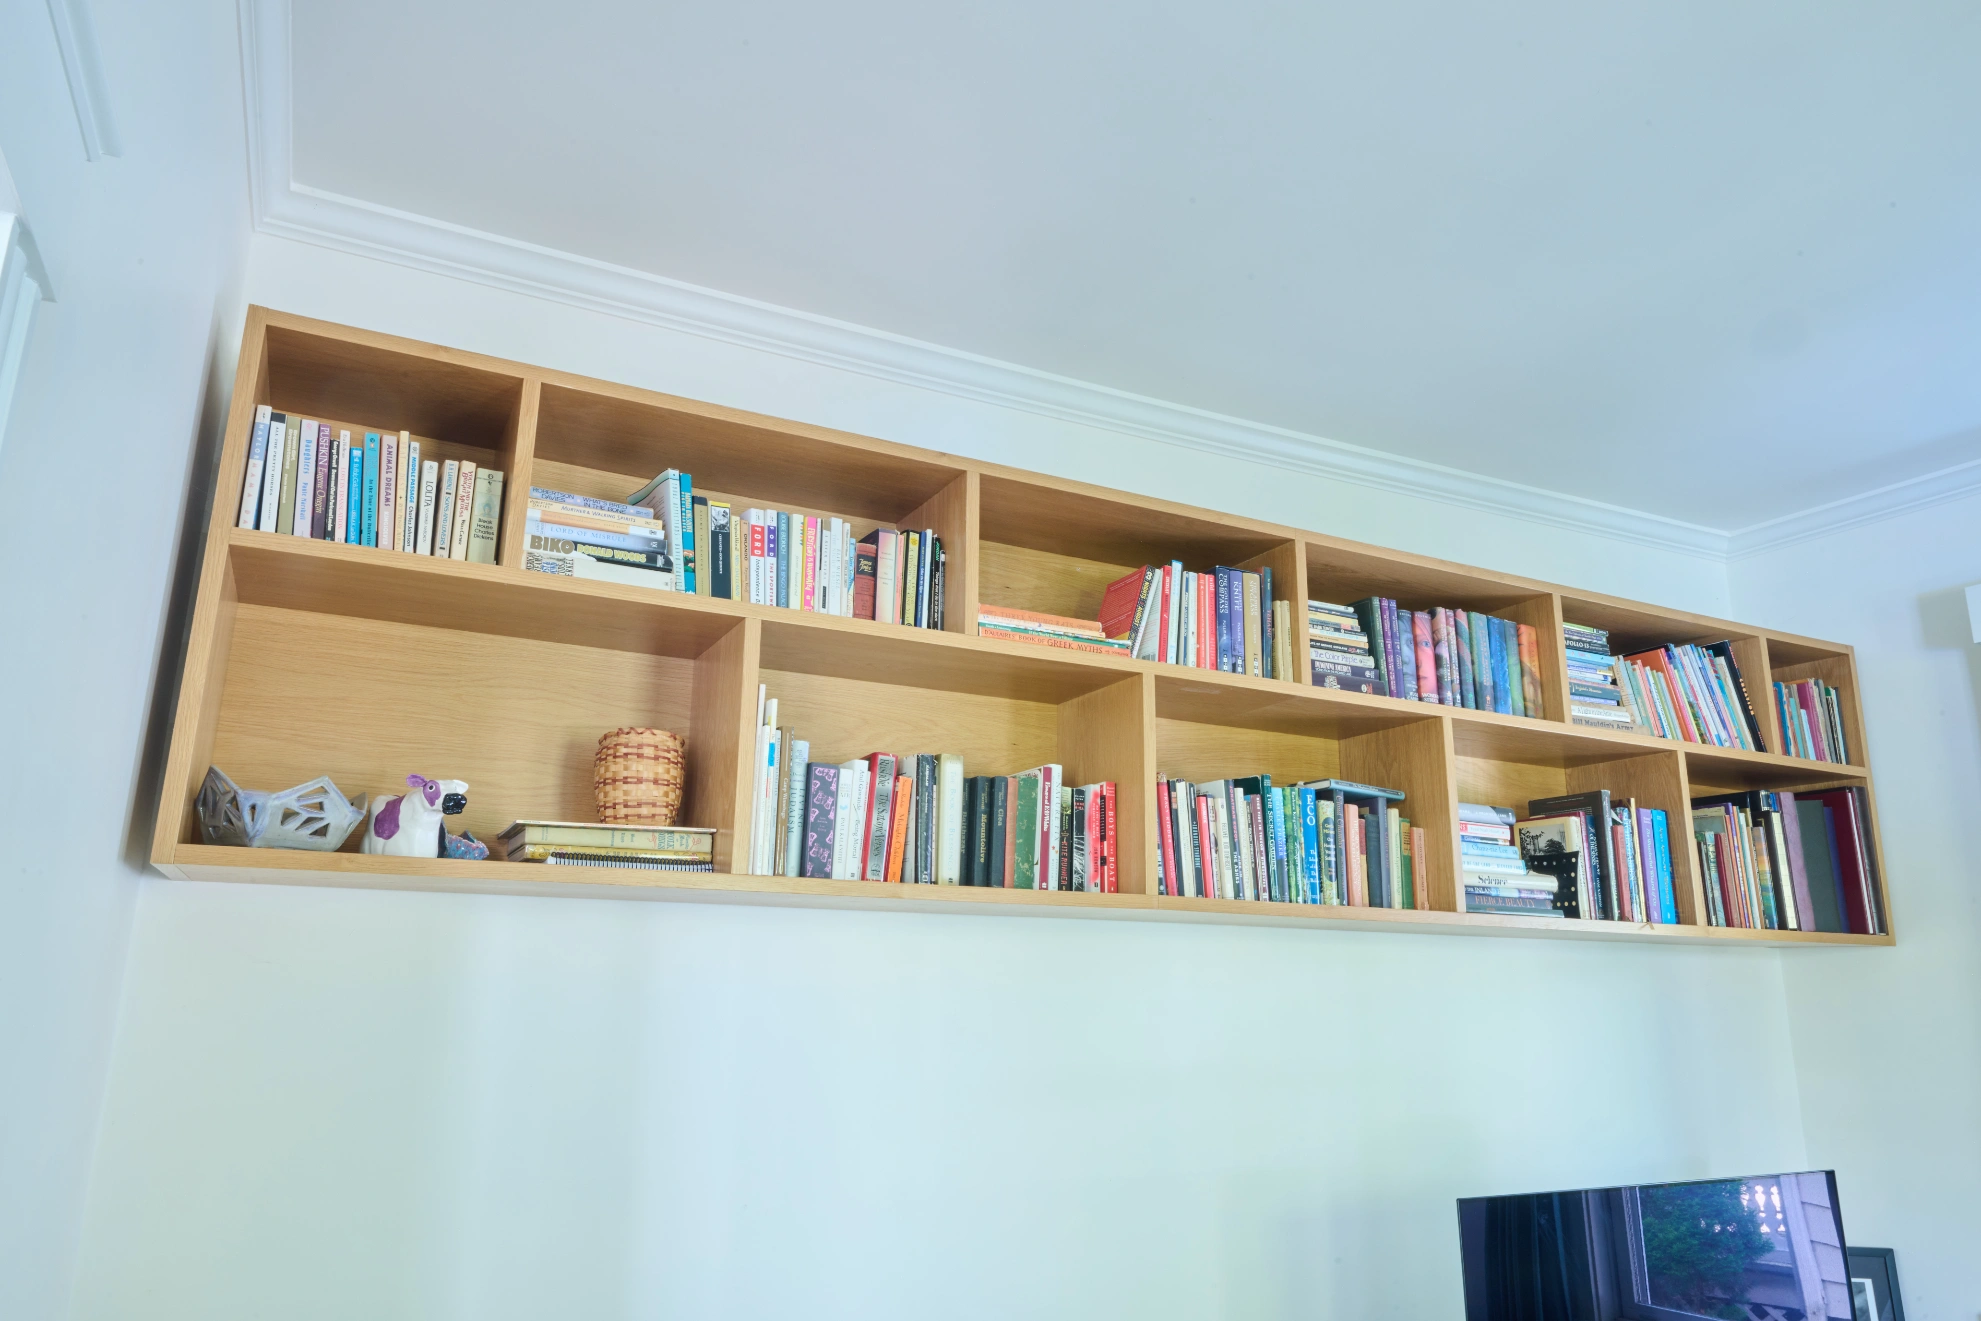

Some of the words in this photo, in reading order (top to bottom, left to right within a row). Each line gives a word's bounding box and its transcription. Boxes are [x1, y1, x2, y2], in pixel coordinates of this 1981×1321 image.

[302, 439, 313, 475] Daughters
[319, 427, 331, 467] PUSHKIN
[385, 443, 394, 475] ANIMAL
[316, 466, 326, 490] Eugene
[314, 489, 326, 514] Onegin
[384, 476, 393, 508] DREAMS
[424, 480, 434, 507] LOLITA
[532, 486, 575, 500] ROBERTSON
[545, 493, 566, 503] DAVIES
[337, 490, 345, 530] TRANSLATION
[607, 506, 626, 515] BONE
[610, 500, 628, 510] BRED
[592, 510, 615, 521] WALKING
[616, 515, 636, 524] SPIRITS
[473, 532, 494, 541] Dickens
[474, 527, 495, 536] Charles
[549, 527, 573, 536] LORD
[591, 533, 627, 543] MISRULE
[754, 526, 762, 555] FORD
[806, 527, 816, 556] EVERYTHING
[529, 533, 575, 555] BIKO
[576, 543, 614, 558] DONALD
[613, 548, 647, 563] WOODS
[779, 570, 788, 589] BINGO
[1140, 581, 1150, 599] NIGHTS
[1133, 605, 1143, 627] AUGUST
[1018, 633, 1035, 642] BOOK
[1047, 638, 1074, 651] GREEK
[1075, 642, 1103, 654] MYTHS
[1314, 650, 1325, 659] The
[1324, 652, 1342, 662] Color
[1341, 654, 1358, 665] Purple
[1739, 678, 1755, 715] CREATION
[1584, 719, 1615, 730] Mauldin's
[877, 758, 892, 787] Rushdie
[797, 788, 806, 828] LIVING
[855, 783, 864, 810] Gawande
[878, 792, 889, 809] The
[948, 788, 958, 811] BOOK
[787, 786, 797, 833] JUDAISM
[874, 808, 889, 834] Satanic
[948, 813, 956, 824] OF
[1305, 794, 1316, 826] ECO
[852, 818, 862, 837] Being
[1267, 810, 1276, 839] SECRET
[1336, 818, 1344, 849] Chamber
[666, 831, 675, 850] FOLK
[851, 838, 860, 859] Mortal
[873, 834, 886, 858] Verses
[979, 813, 988, 863] Mountolive
[947, 827, 957, 873] BLESSINGS
[1646, 838, 1654, 869] Wonderful
[1652, 897, 1657, 907] Oz
[1474, 895, 1504, 906] FIERCE
[1505, 898, 1536, 909] BEAUTY
